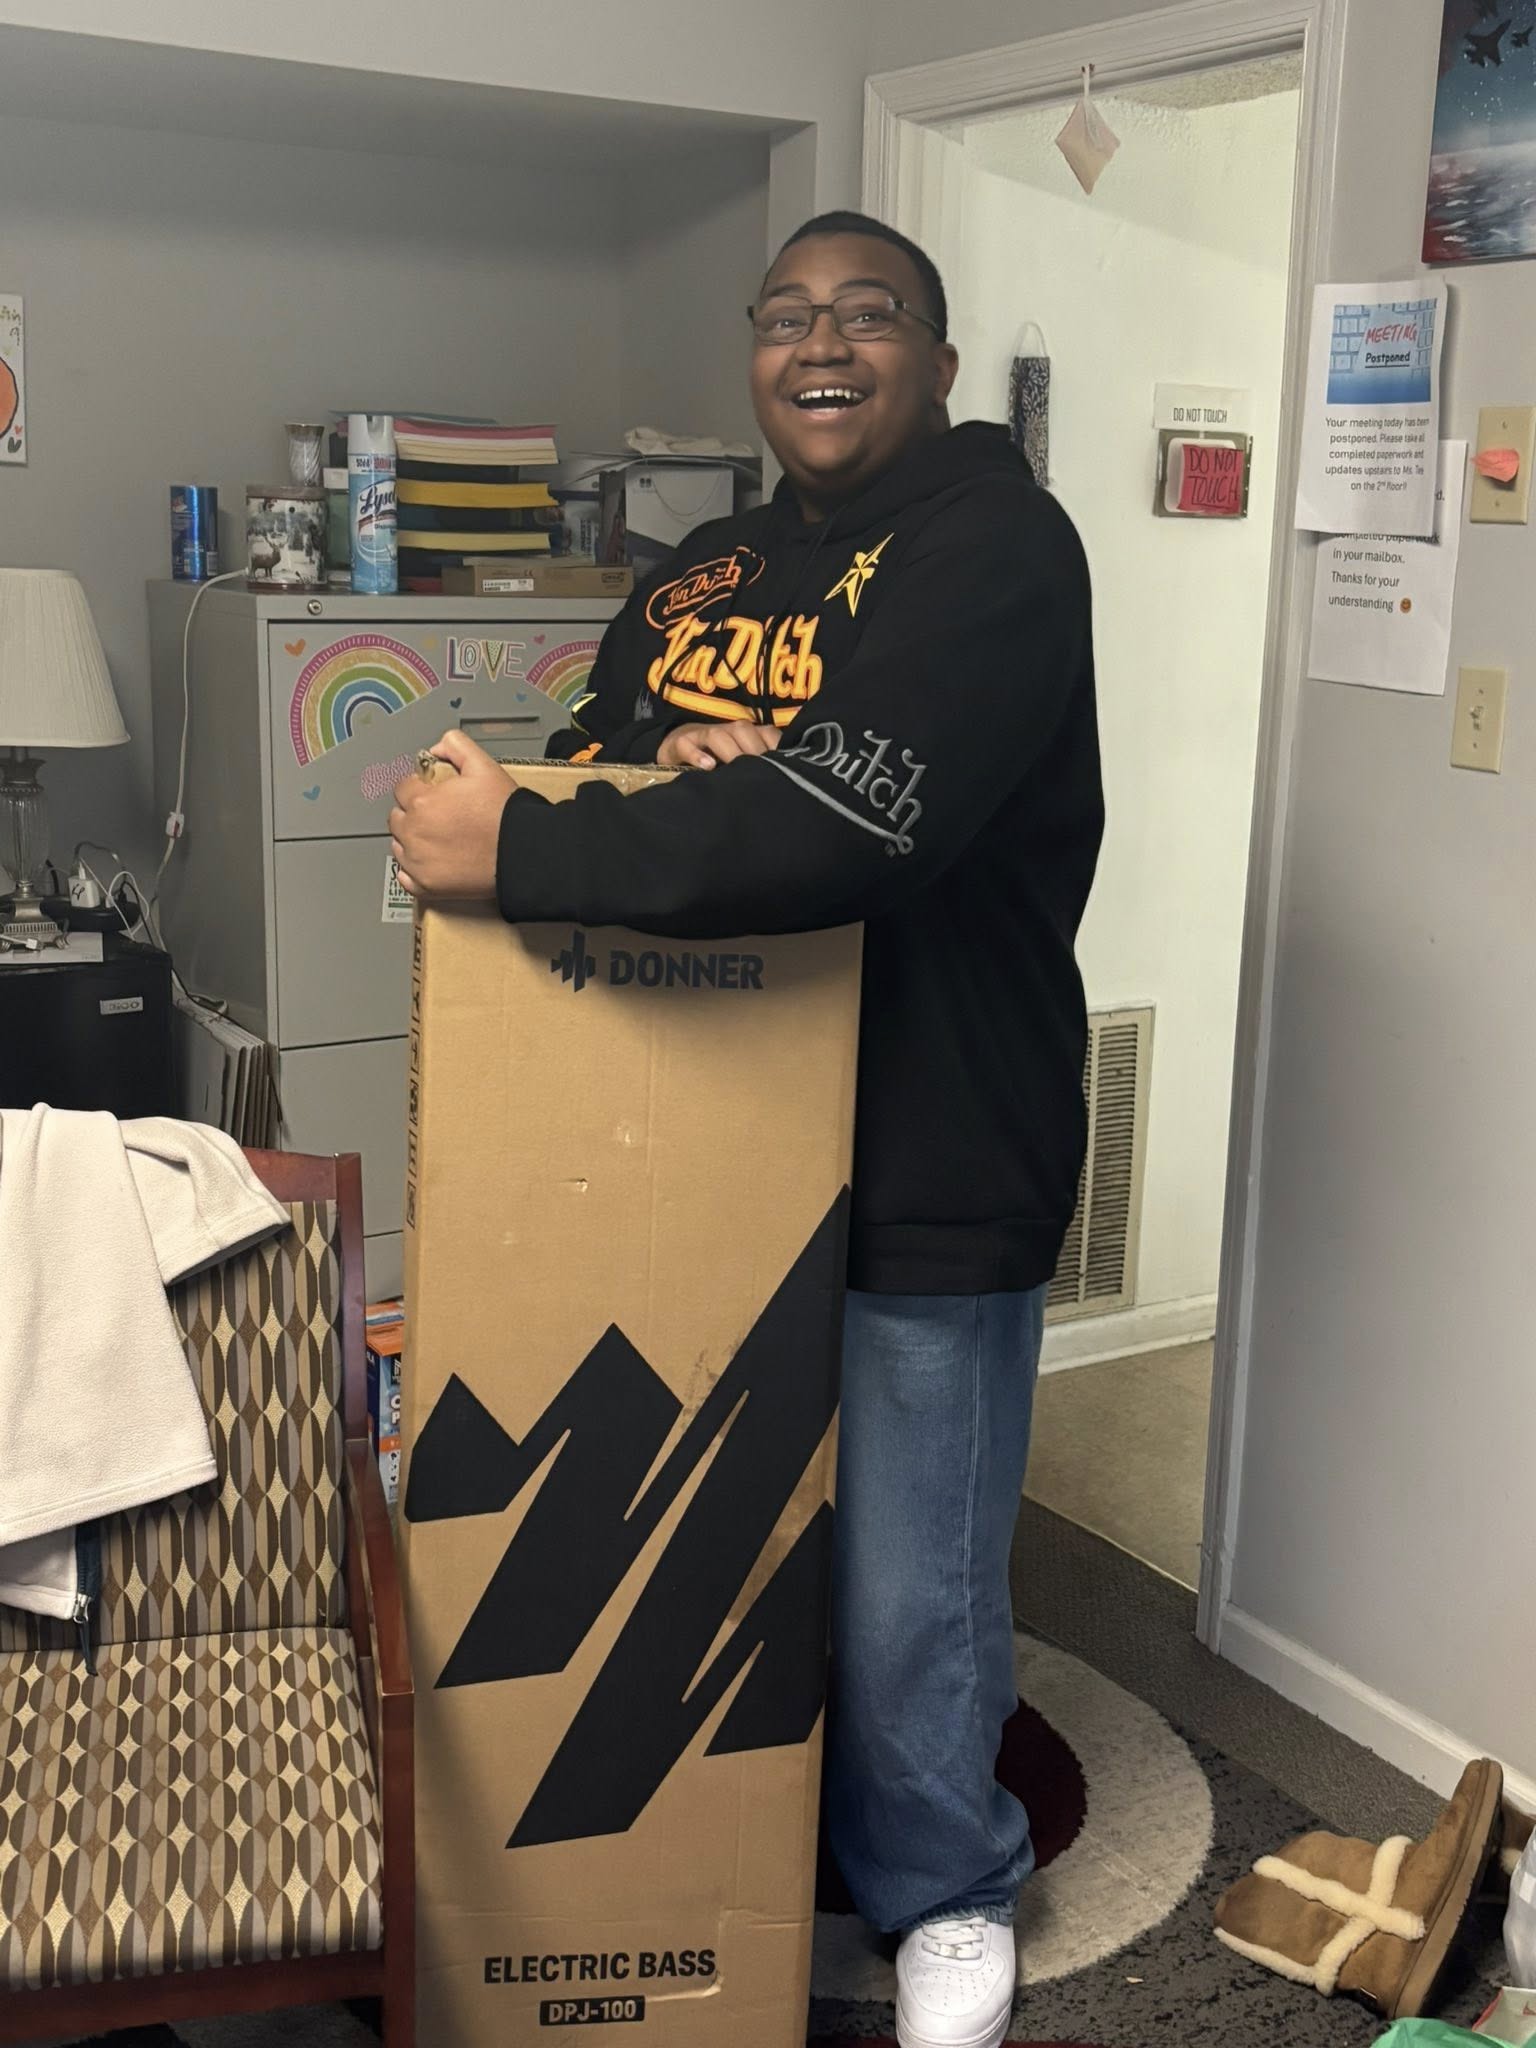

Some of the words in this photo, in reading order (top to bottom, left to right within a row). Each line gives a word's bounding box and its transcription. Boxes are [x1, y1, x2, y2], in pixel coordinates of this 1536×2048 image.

[1365, 323, 1418, 345] MEETING
[1365, 351, 1411, 366] Postponed
[1173, 407, 1185, 421] DO
[1186, 408, 1201, 422] NOT
[1203, 408, 1228, 423] TOUCH
[1325, 417, 1347, 428] Your
[1349, 418, 1383, 429] meeting
[1384, 417, 1403, 429] today
[1404, 417, 1416, 427] has
[1380, 433, 1403, 443] Please
[1404, 433, 1417, 443] take
[1189, 447, 1210, 474] DO
[1213, 449, 1238, 473] NOT
[1329, 449, 1375, 460] completed
[1376, 449, 1412, 460] paperwork
[1325, 465, 1362, 476] updates
[1364, 466, 1392, 476] upstairs
[1393, 466, 1401, 475] to
[1188, 475, 1239, 505] TOUCH
[1351, 482, 1361, 490] on
[1363, 481, 1375, 490] the
[1333, 548, 1342, 559] in
[1343, 550, 1363, 562] your
[1365, 551, 1405, 564] mailbox.
[1332, 571, 1362, 585] Thanks
[1364, 573, 1376, 585] for
[1377, 575, 1400, 588] your
[1328, 595, 1394, 613] understanding
[447, 636, 527, 682] LOVE
[780, 721, 928, 855] Dutch
[608, 950, 764, 990] DONNER
[484, 1952, 630, 1984] ELECTRIC
[638, 1949, 716, 1979] BASS
[549, 1999, 637, 2024] DPJ-100
